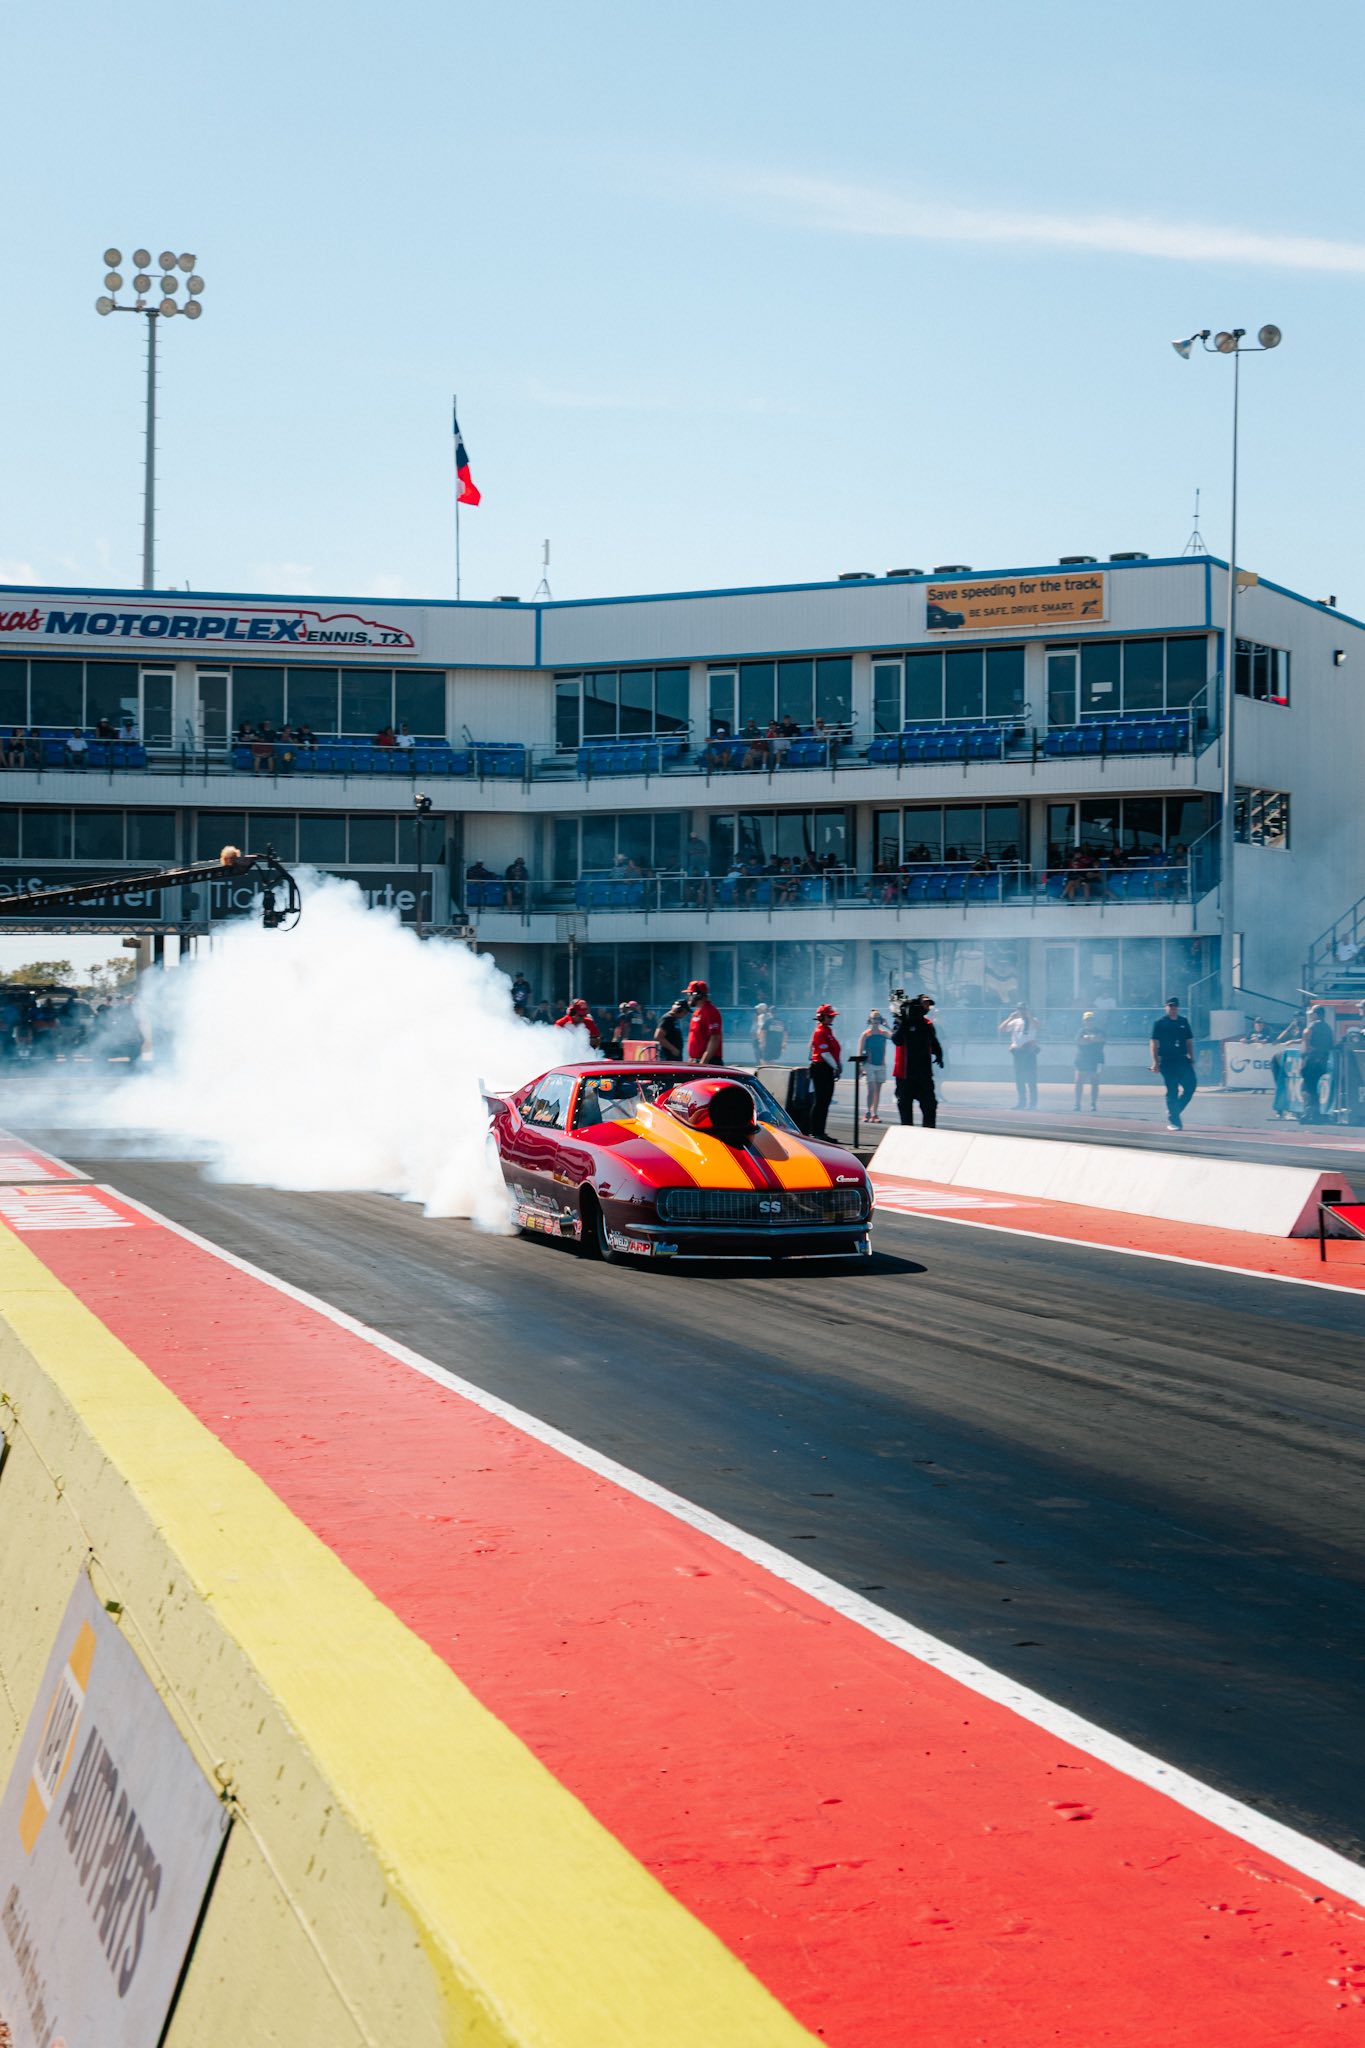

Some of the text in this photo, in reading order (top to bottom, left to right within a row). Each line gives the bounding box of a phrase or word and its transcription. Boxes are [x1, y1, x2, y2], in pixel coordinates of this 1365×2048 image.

[929, 577, 1102, 601] Save speeding for the track.
[969, 608, 982, 618] BE
[1011, 604, 1039, 614] DRIVE
[45, 610, 305, 642] MOTORPLEX
[307, 630, 405, 644] ENNIS, TX
[600, 1078, 613, 1091] 5
[760, 1201, 781, 1213] SS
[630, 1240, 651, 1253] ARP
[59, 1725, 162, 1999] AUTO PARTS
